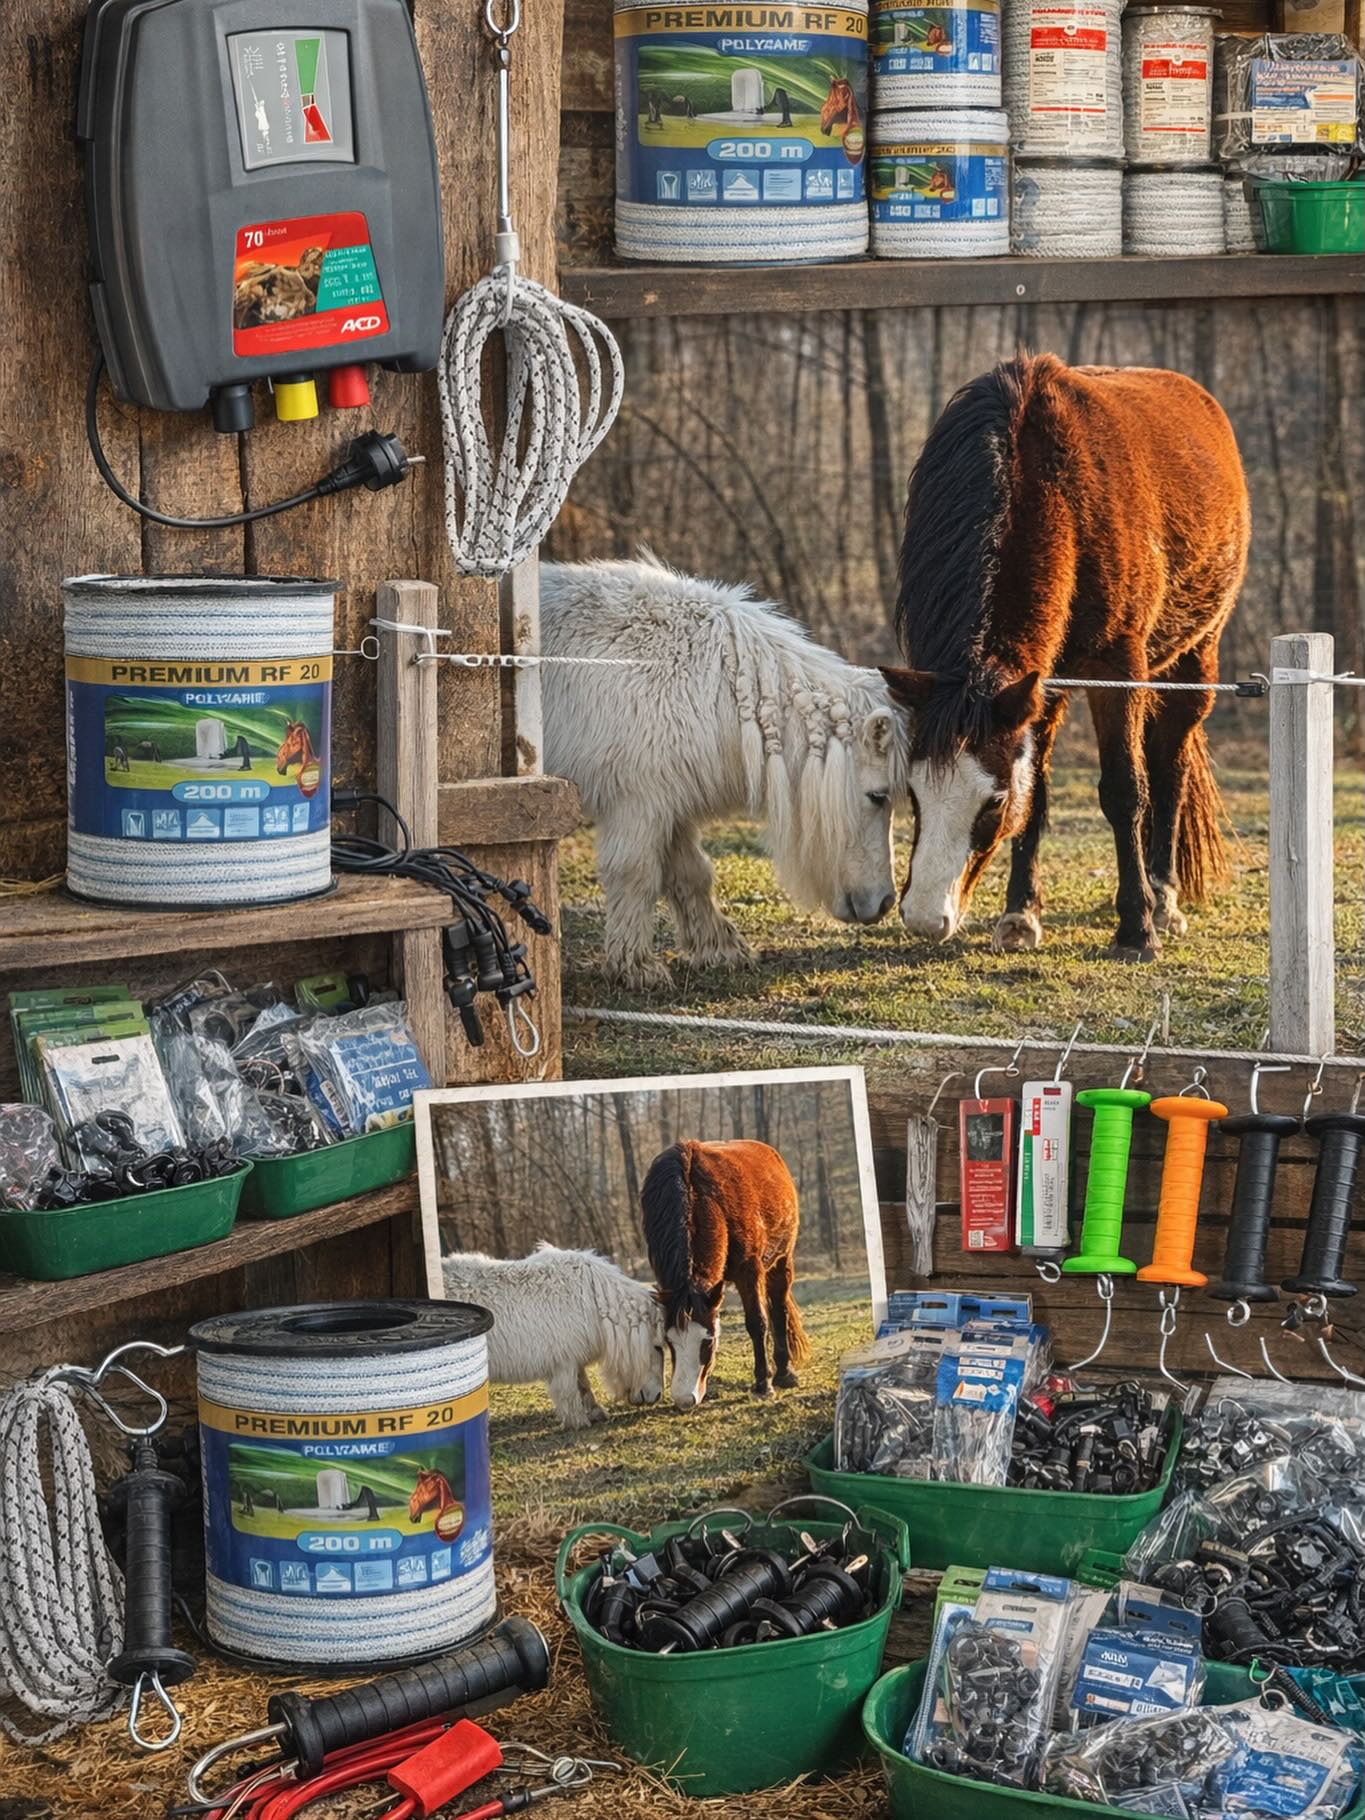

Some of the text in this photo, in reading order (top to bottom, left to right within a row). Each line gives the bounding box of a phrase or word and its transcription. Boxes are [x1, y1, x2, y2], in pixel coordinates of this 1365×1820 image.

[646, 10, 863, 33] PREMIUM RF 20
[719, 142, 803, 158] 200 m
[244, 230, 264, 248] 70
[111, 663, 320, 683] PREMIUM RF 20
[183, 785, 261, 799] 200 m
[235, 1406, 454, 1435] PREMIUM RF 20
[308, 1535, 393, 1551] 200 m
